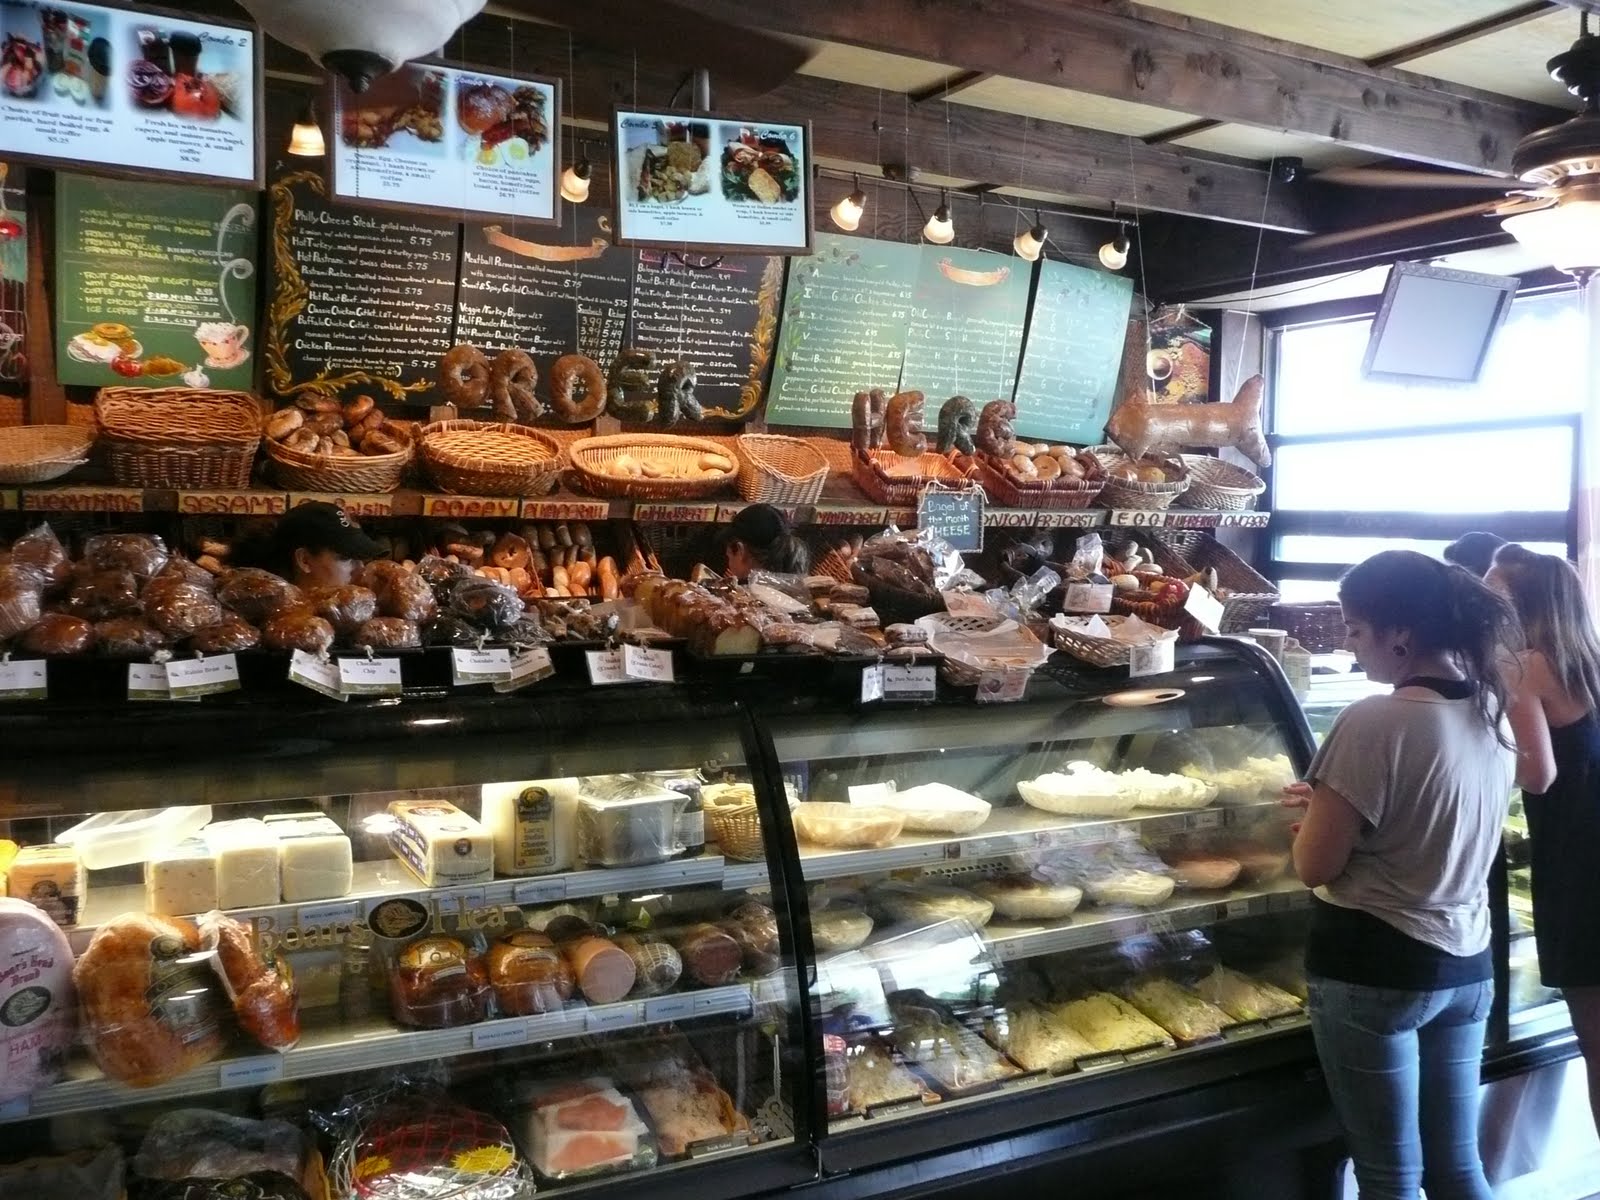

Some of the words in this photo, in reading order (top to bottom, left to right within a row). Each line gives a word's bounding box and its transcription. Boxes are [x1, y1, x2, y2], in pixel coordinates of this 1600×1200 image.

[409, 236, 432, 247] 5.75
[411, 359, 437, 369] 5.75
[181, 495, 285, 513] SESAME
